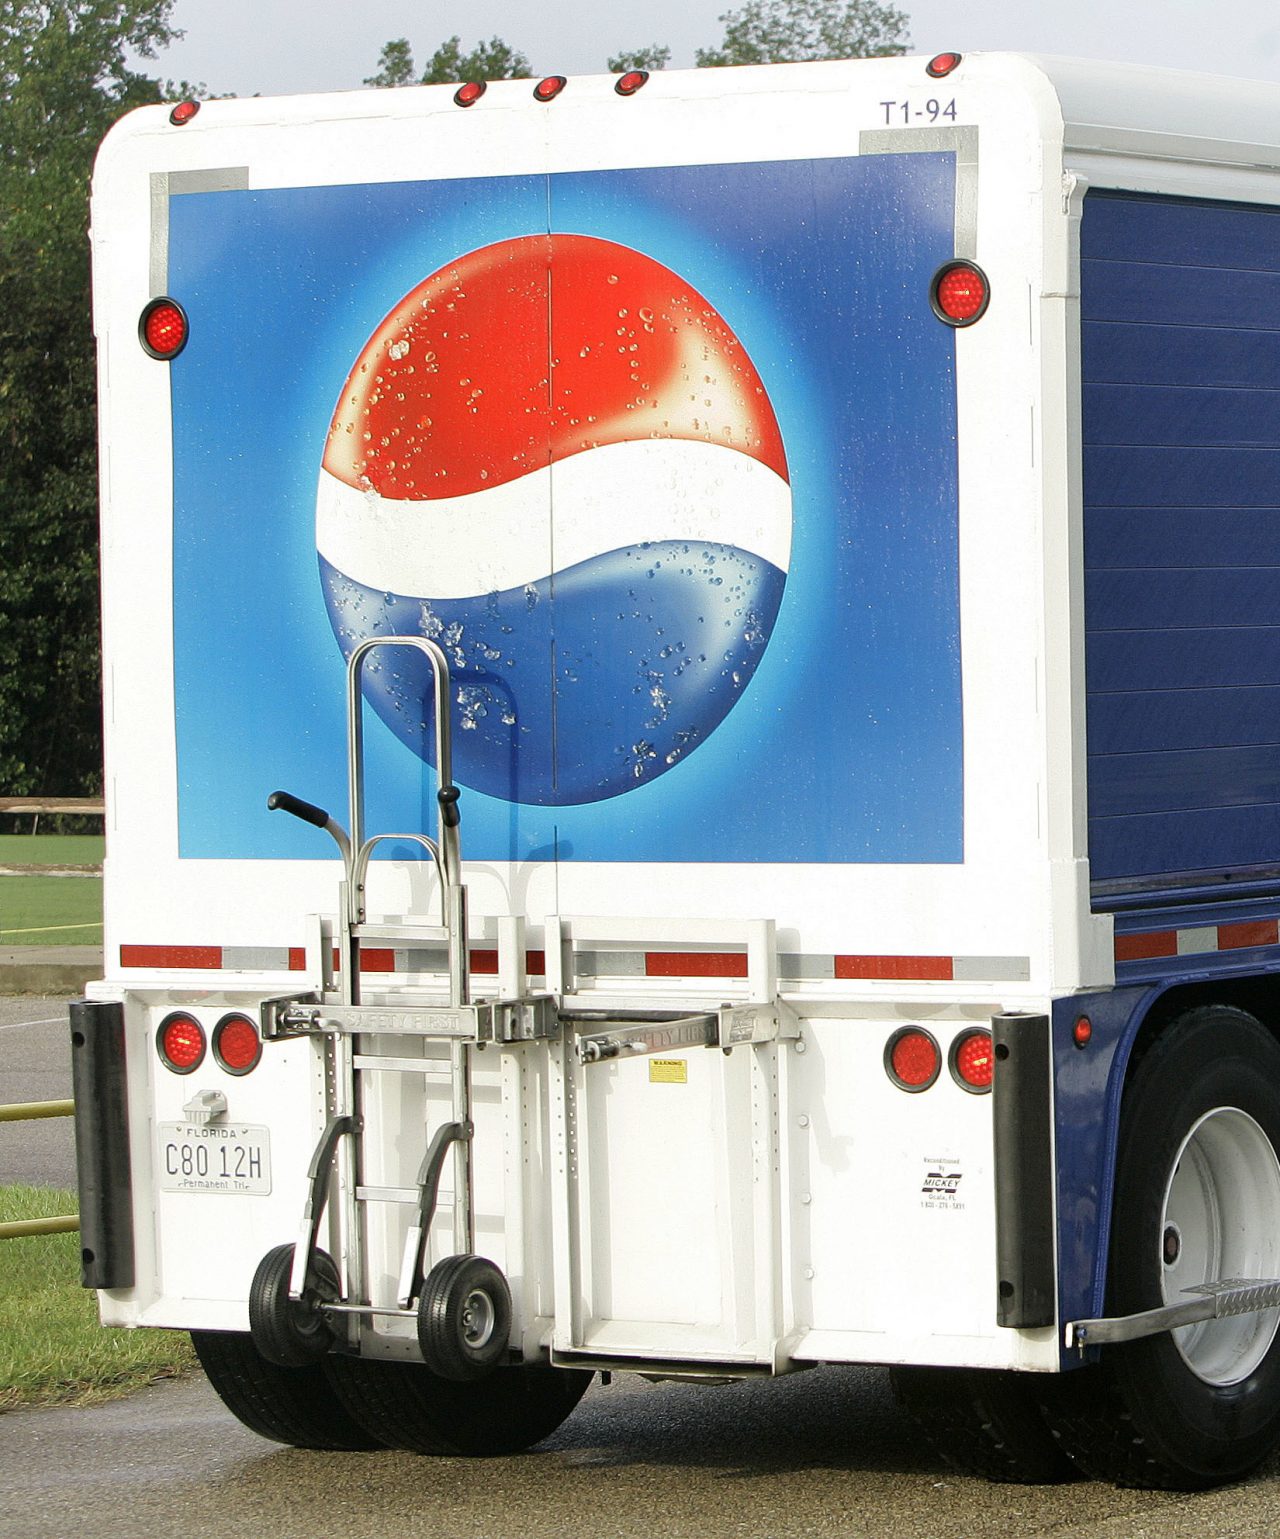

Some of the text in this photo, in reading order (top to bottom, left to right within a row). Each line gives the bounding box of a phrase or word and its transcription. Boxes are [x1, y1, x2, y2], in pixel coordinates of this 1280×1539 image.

[880, 98, 957, 125] T1-94
[346, 1012, 459, 1031] SAFETY FIRST
[187, 1129, 237, 1138] FLORIDA
[166, 1144, 261, 1178] C80 12H
[184, 1179, 228, 1188] Permanent
[923, 1179, 960, 1187] MICKEY
